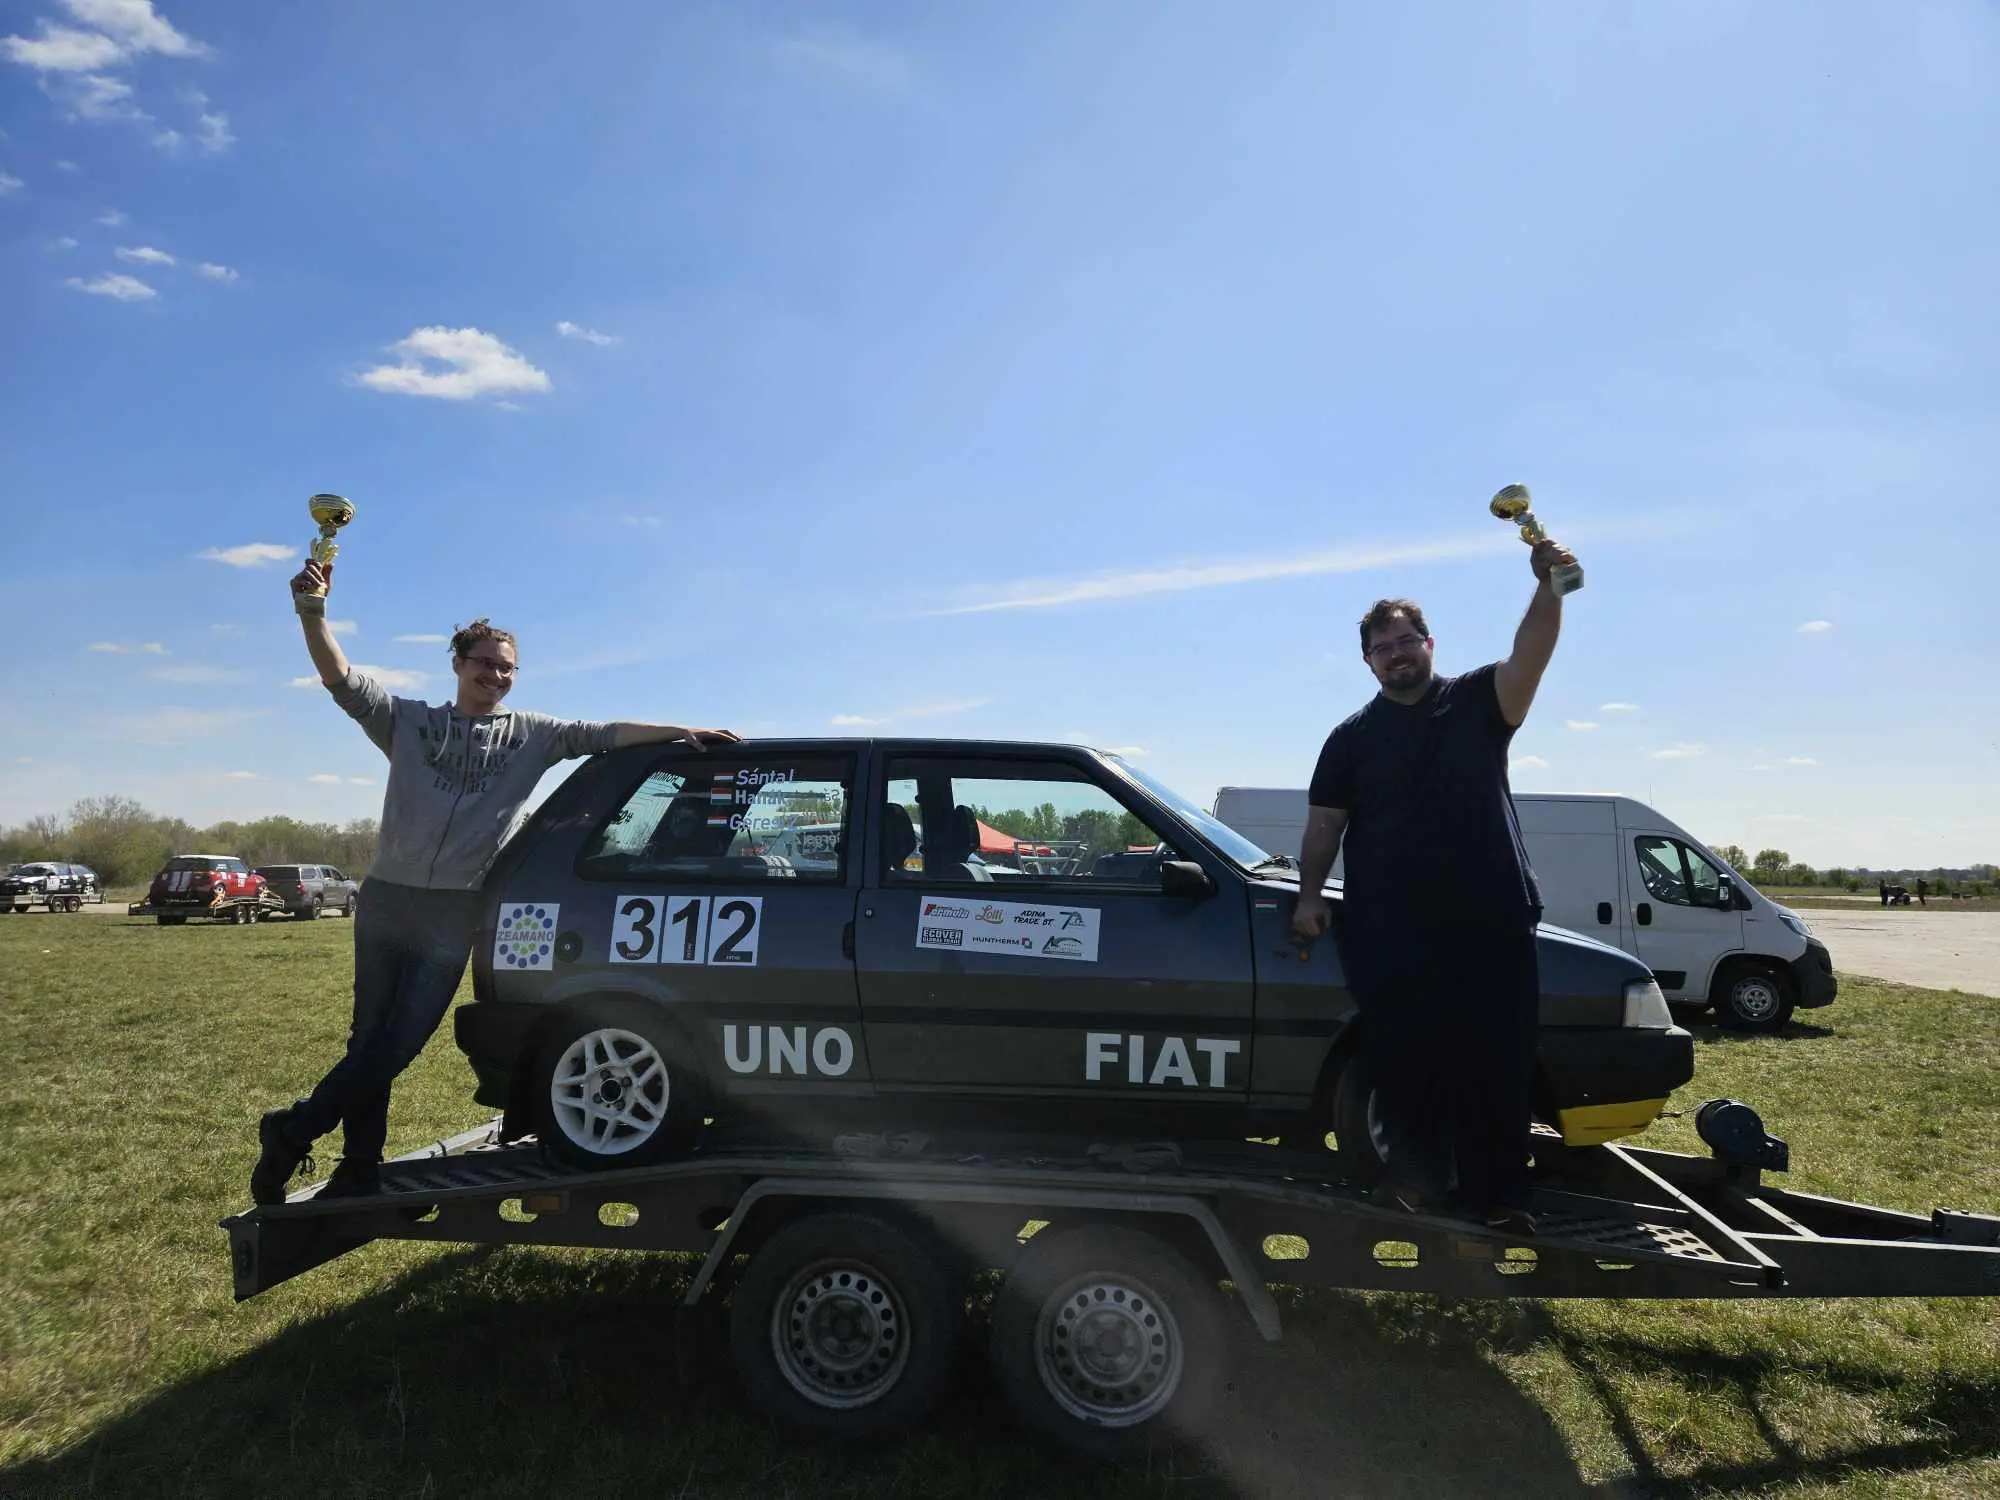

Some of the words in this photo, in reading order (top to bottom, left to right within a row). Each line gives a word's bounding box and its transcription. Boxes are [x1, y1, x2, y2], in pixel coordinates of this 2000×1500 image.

[615, 898, 757, 963] 312
[722, 1024, 855, 1076] UNO
[1084, 1032, 1241, 1088] FIAT
